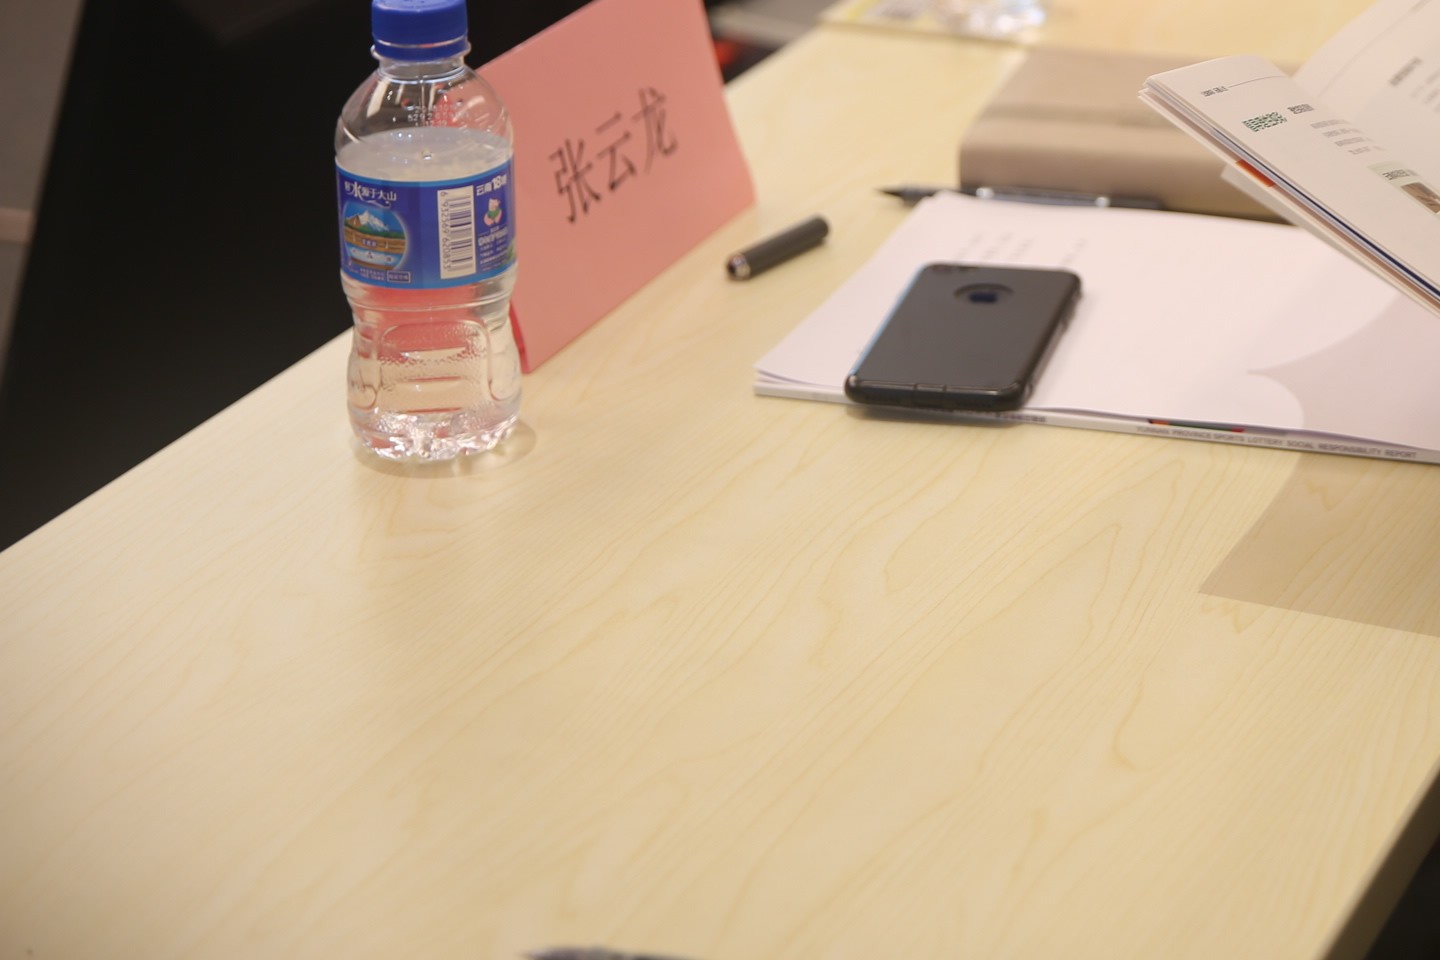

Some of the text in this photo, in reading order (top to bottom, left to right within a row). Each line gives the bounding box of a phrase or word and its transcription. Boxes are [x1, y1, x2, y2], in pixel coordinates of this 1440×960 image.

[548, 87, 679, 224] 张云龙
[1247, 436, 1283, 447] LOTTERY
[1286, 439, 1314, 450] SOCIAL
[1384, 448, 1418, 459] REPORT
